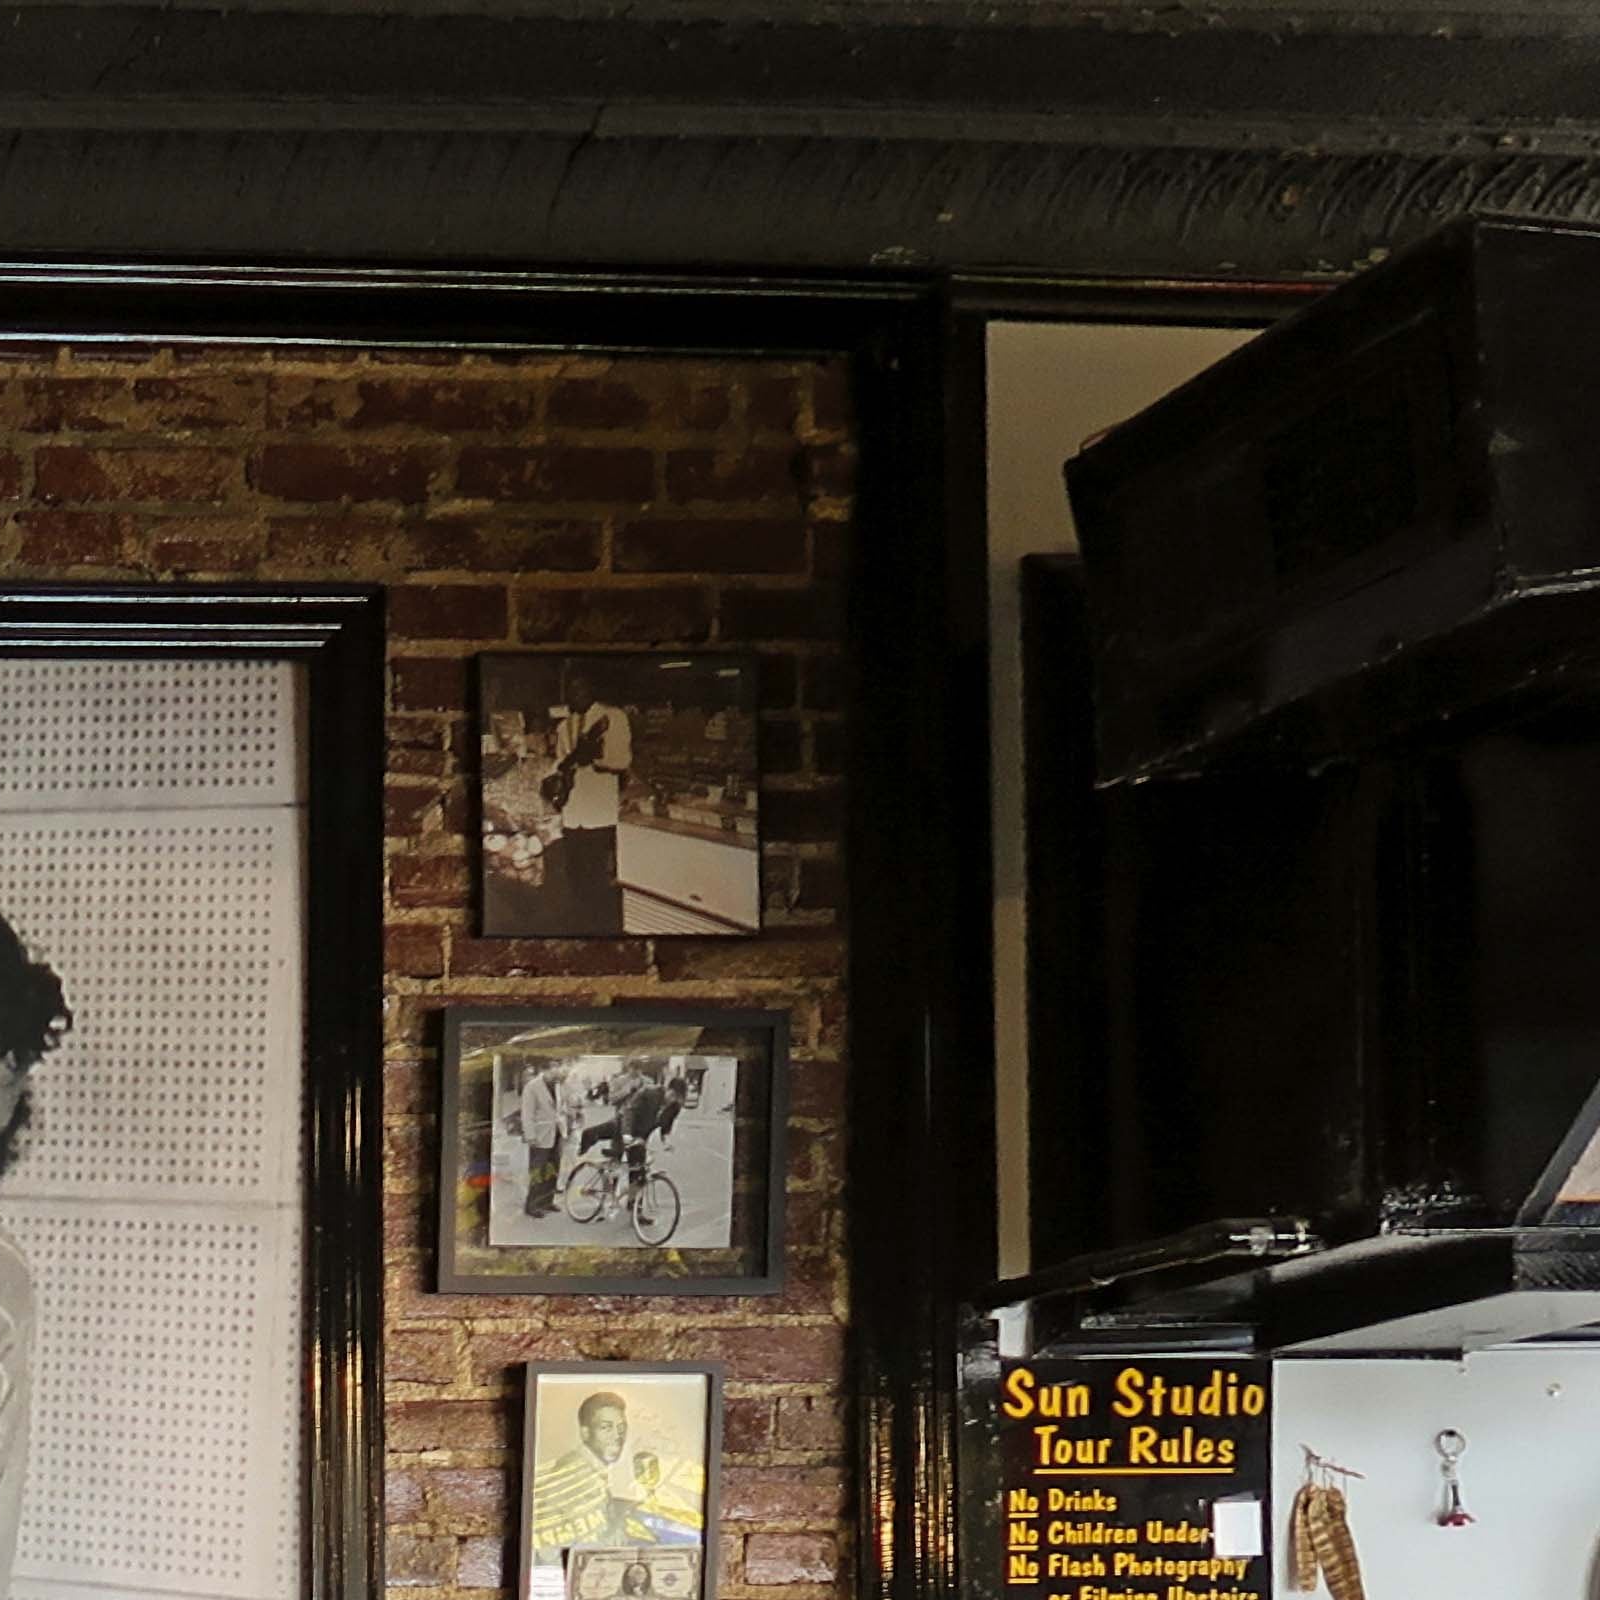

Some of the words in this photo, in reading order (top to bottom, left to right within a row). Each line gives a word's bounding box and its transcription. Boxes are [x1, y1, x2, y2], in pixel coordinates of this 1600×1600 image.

[1004, 1368, 1090, 1419] Sun
[1113, 1367, 1266, 1418] Studio
[1034, 1425, 1112, 1465] Tour
[1130, 1426, 1235, 1465] Rules
[1009, 1489, 1039, 1513] No
[1048, 1489, 1117, 1512] Drinks
[1009, 1522, 1039, 1546] No
[1048, 1522, 1137, 1545] Children
[1146, 1521, 1209, 1545] Under
[1009, 1554, 1039, 1578] No
[1049, 1553, 1105, 1578] Flash
[1114, 1553, 1248, 1584] Photography
